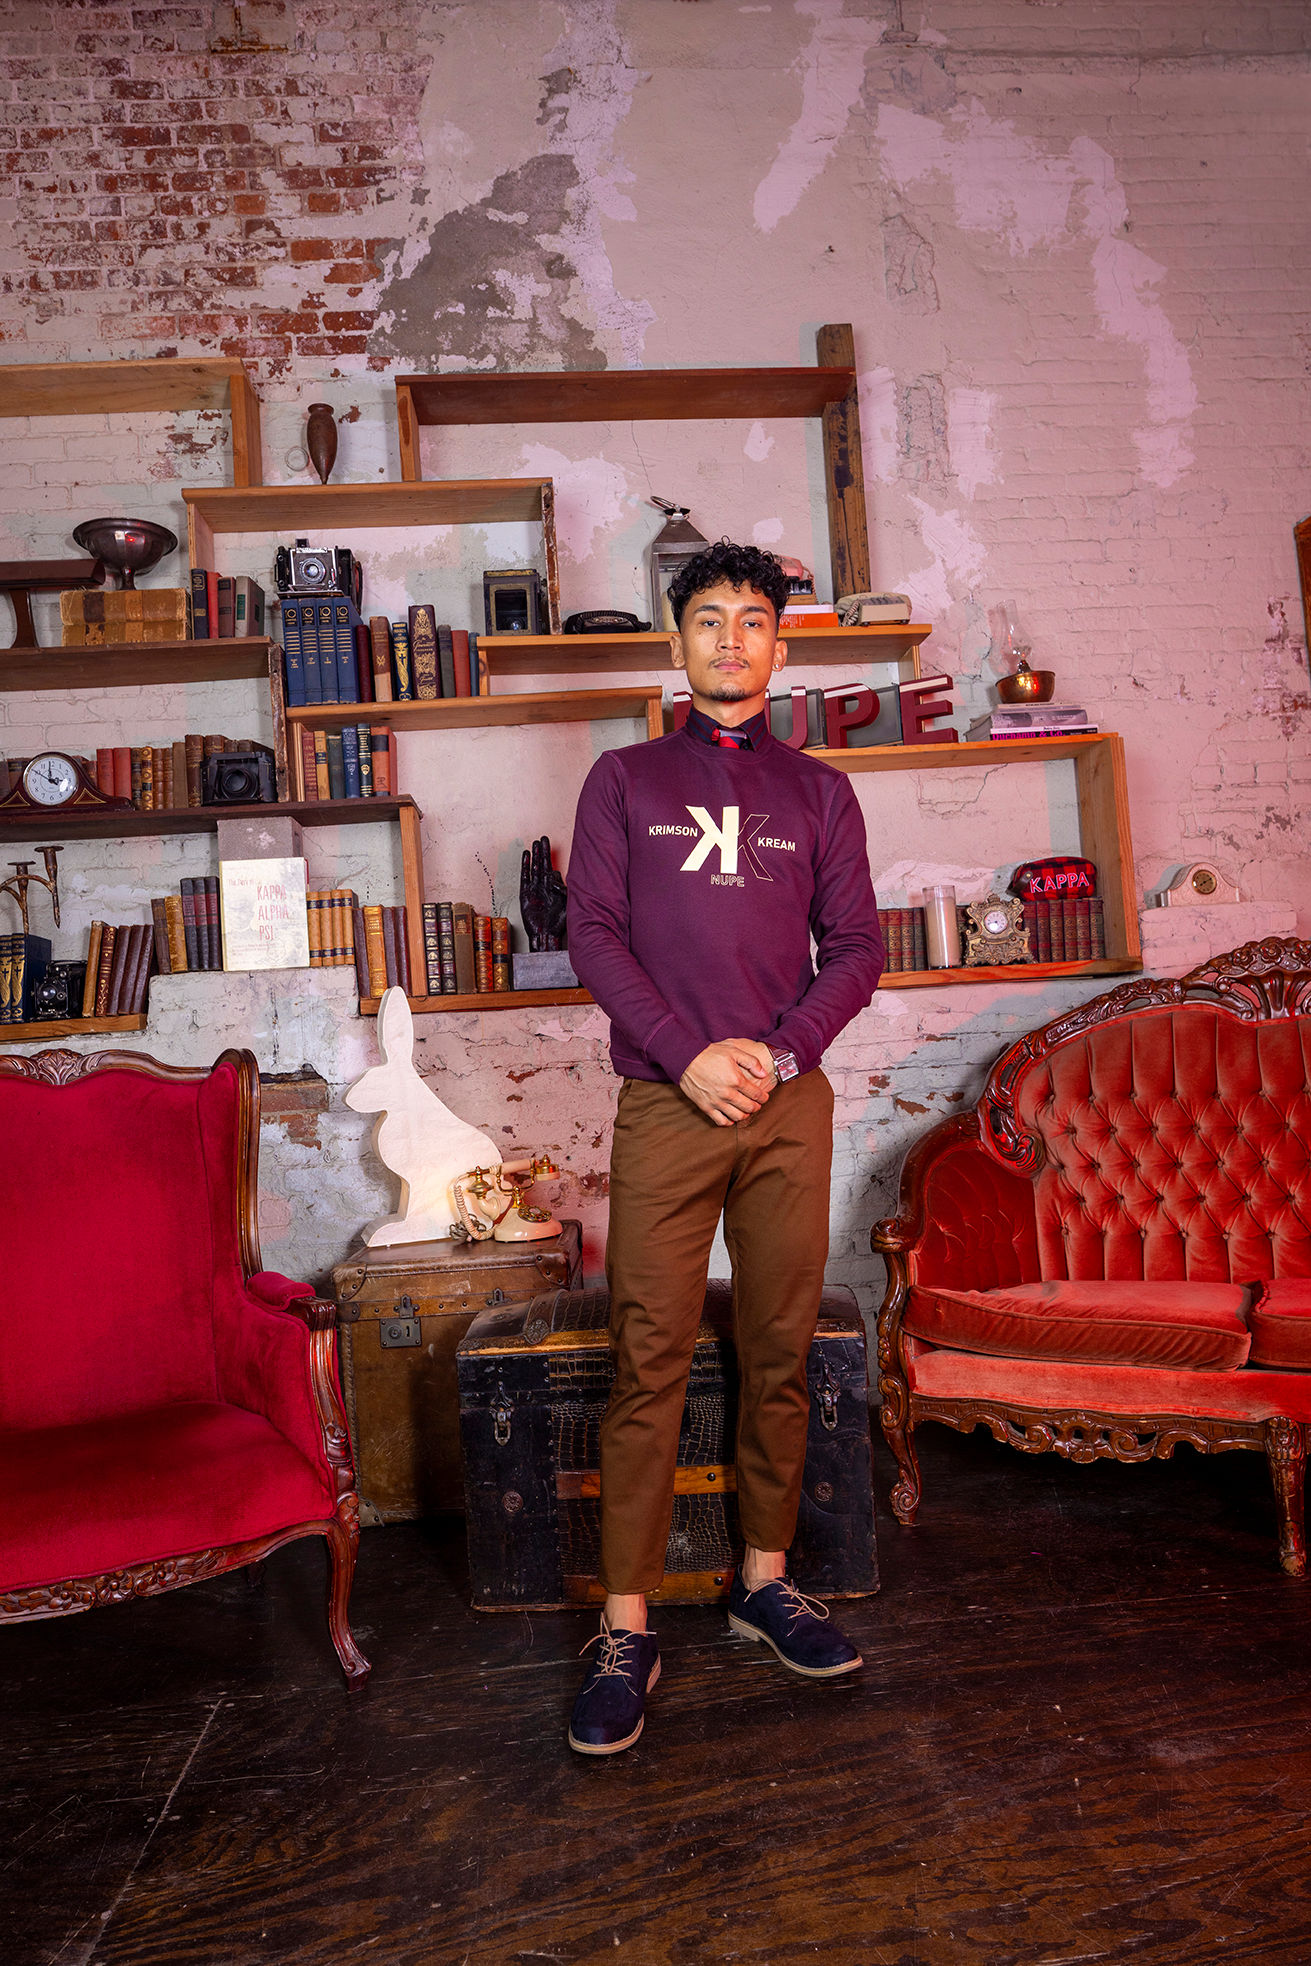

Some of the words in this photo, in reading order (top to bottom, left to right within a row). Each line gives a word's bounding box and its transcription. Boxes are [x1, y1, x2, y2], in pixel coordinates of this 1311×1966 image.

[648, 825, 698, 838] KRIMSON
[757, 836, 796, 852] KREAM
[710, 874, 745, 887] NUPE
[1030, 872, 1089, 893] KAPPA
[256, 884, 287, 901] KAPPA
[257, 904, 289, 921] ALPHA
[259, 924, 274, 940] PSI
